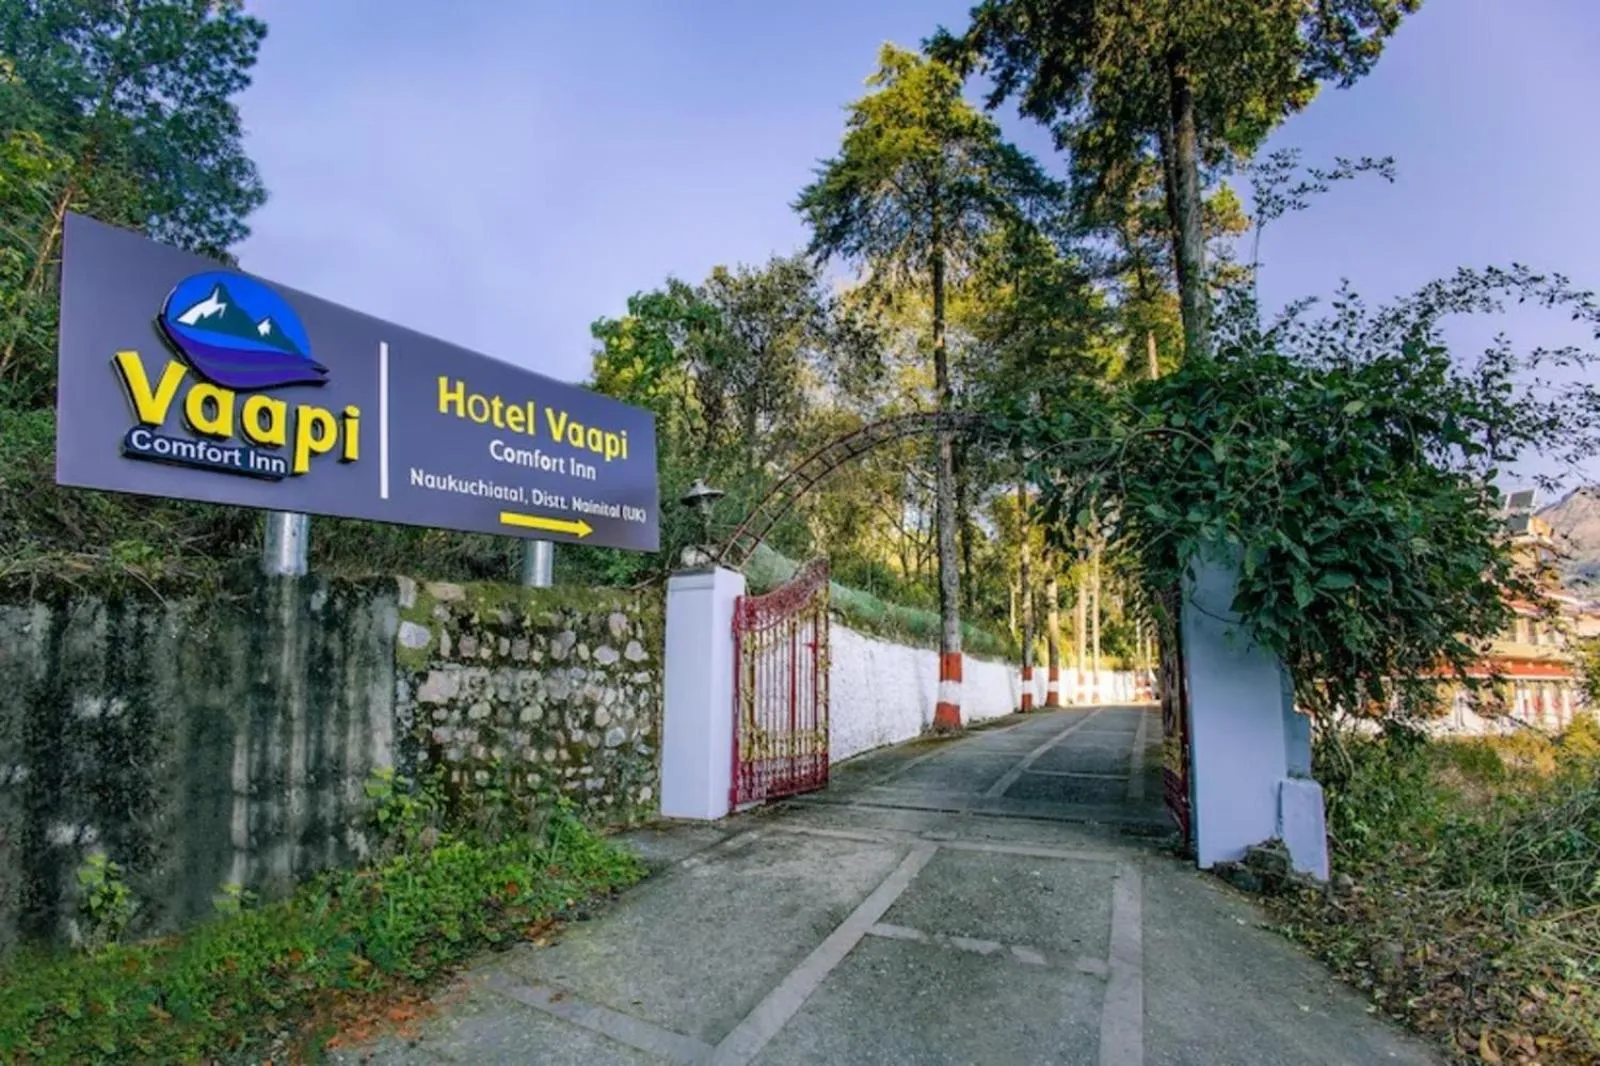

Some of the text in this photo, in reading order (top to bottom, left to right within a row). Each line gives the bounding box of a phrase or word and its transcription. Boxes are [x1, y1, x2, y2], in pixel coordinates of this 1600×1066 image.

[112, 349, 361, 475] Vaapi
[437, 376, 629, 462] Hotel Vaapi
[130, 428, 286, 474] Comfort Inn
[489, 439, 597, 481] Comfort Inn
[572, 496, 620, 518] Nainital
[622, 504, 647, 523] (UK)
